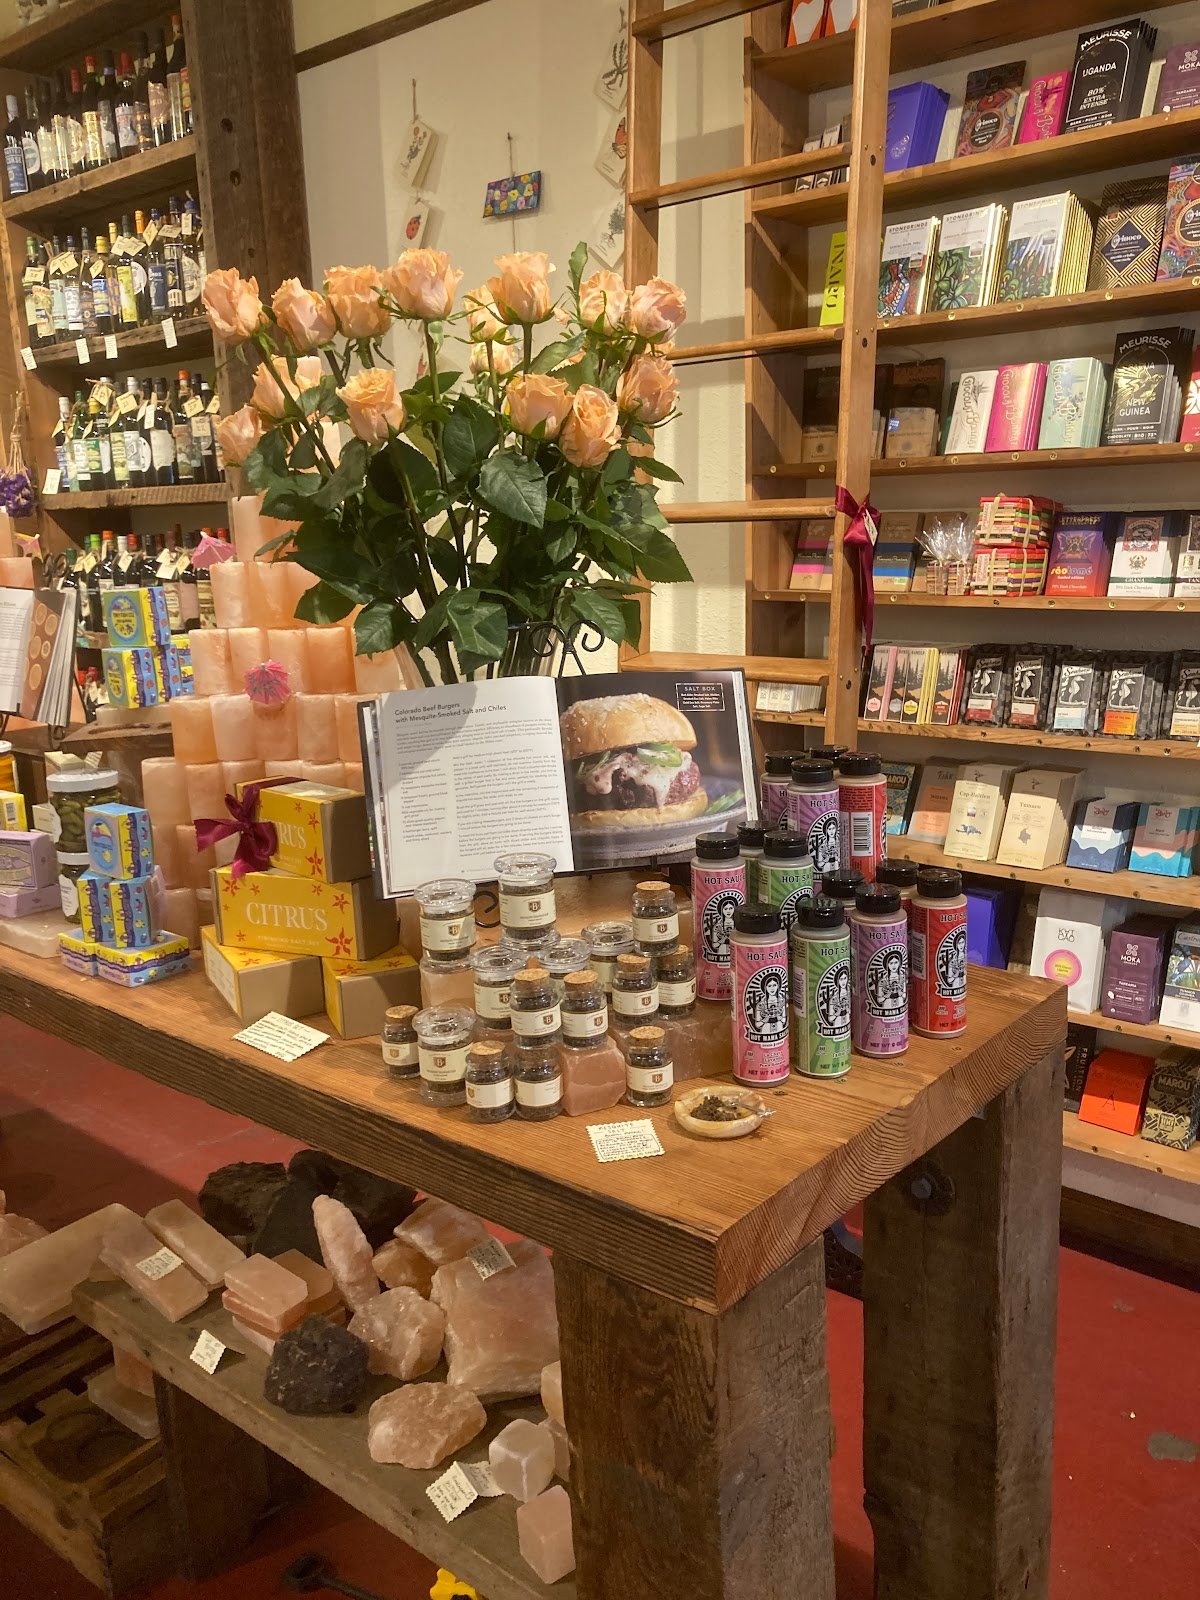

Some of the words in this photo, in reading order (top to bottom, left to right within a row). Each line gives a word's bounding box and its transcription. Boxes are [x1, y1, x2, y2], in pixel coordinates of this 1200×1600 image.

[1081, 28, 1132, 51] MEURISSE
[1082, 62, 1117, 77] UGANDA
[1178, 62, 1200, 71] MOKA
[1083, 94, 1106, 104] EXTRA
[1080, 99, 1108, 110] INTENSE
[1120, 335, 1172, 354] MEURISSE
[1126, 398, 1146, 406] NEW
[1119, 407, 1151, 417] GUINEA
[394, 708, 421, 716] Colorado
[423, 704, 436, 712] Beef
[437, 702, 460, 711] Burgers
[395, 715, 409, 723] with
[409, 710, 460, 722] Mesquite-Smoked
[462, 707, 473, 715] Salt
[488, 704, 507, 712] Chiles
[886, 776, 907, 784] AROU
[810, 799, 827, 807] HOT
[704, 877, 722, 885] HOT
[782, 875, 799, 884] HOT
[246, 901, 328, 932] CITRUS
[941, 914, 957, 922] HOT
[869, 932, 886, 940] HOT
[747, 952, 764, 961] HOT
[821, 948, 839, 957] HOT
[1120, 955, 1141, 964] MOKA
[884, 1008, 899, 1016] MAMA
[762, 1034, 778, 1042] MAMA
[1158, 1076, 1191, 1091] MAROU
